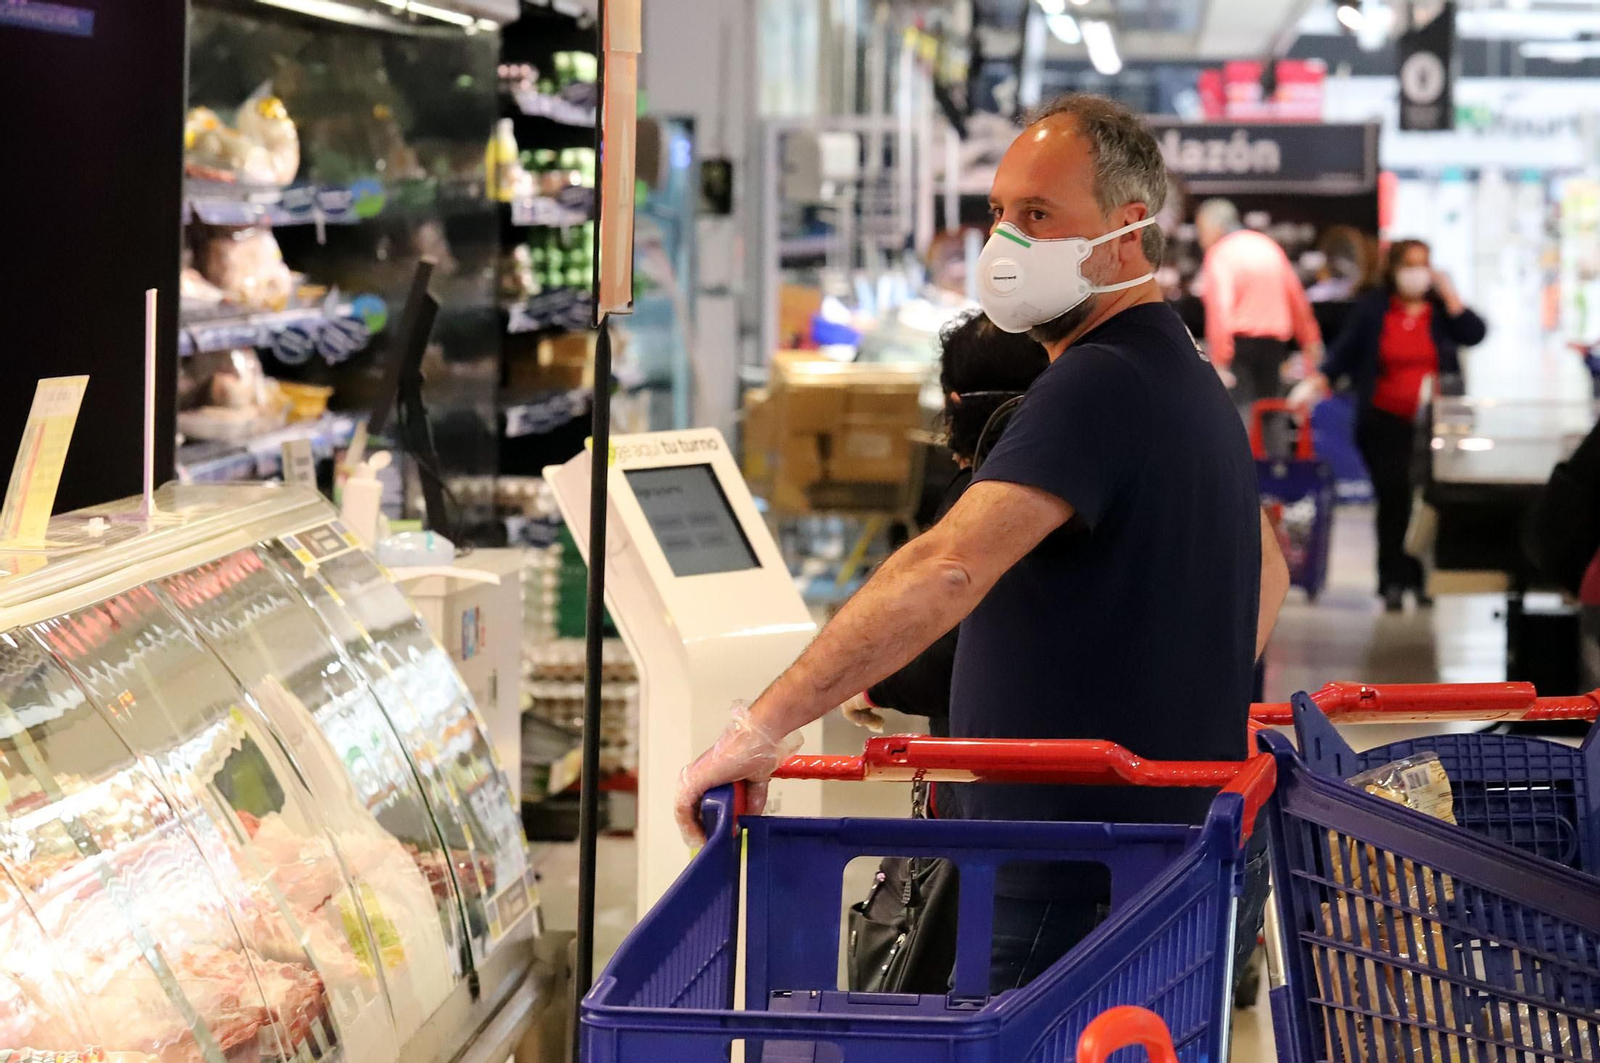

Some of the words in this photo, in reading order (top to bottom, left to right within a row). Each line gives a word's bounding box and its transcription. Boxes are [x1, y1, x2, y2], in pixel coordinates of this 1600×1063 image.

[1158, 128, 1281, 174] lazón
[660, 440, 678, 454] tu
[678, 438, 719, 453] turno
